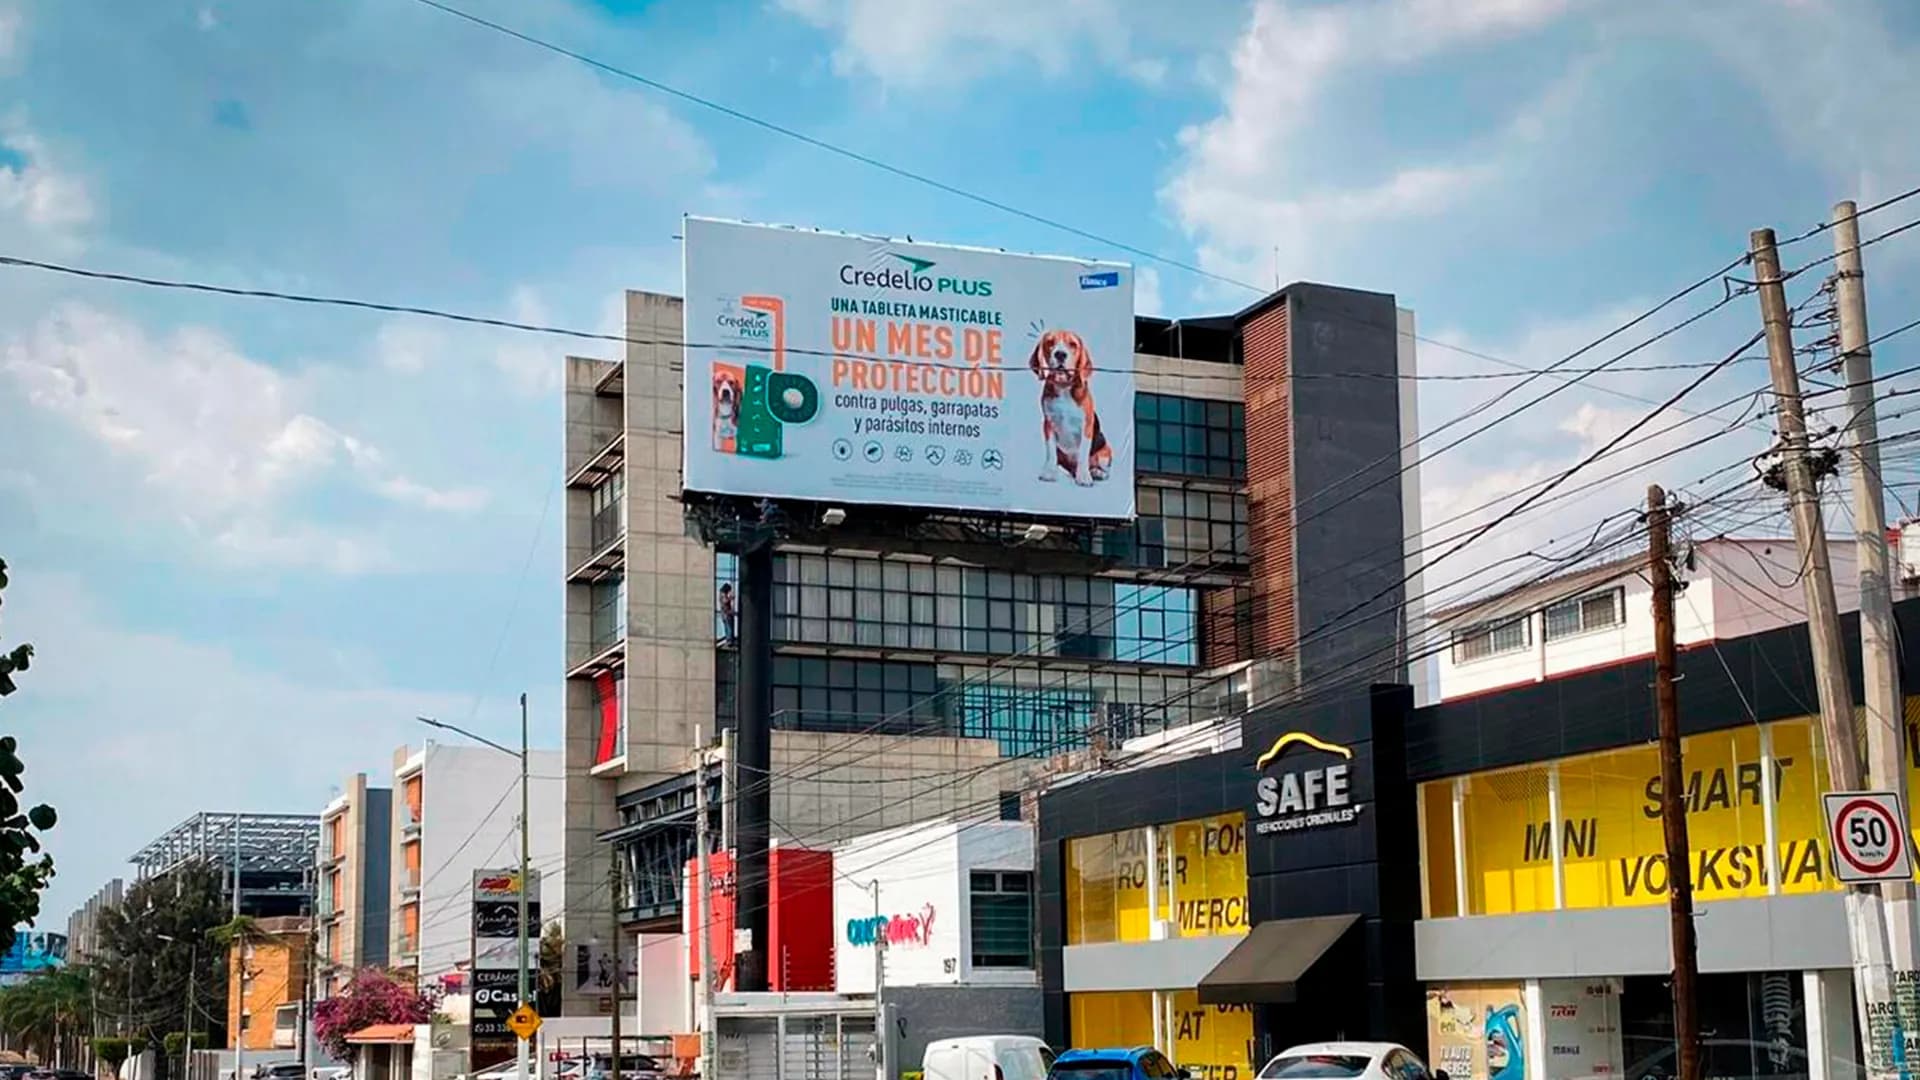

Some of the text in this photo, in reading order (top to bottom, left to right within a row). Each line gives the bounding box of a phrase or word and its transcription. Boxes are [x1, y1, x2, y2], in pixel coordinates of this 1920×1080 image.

[840, 264, 993, 297] Credelio PLUS
[717, 314, 769, 338] Credelio PLUS
[831, 297, 1003, 326] UNA TABLETA MASTICABLE
[831, 316, 1003, 364] UN MES DE
[832, 359, 1003, 401] PROTECCIÓN
[835, 394, 999, 421] contra pulgas, garrapatas
[854, 415, 981, 438] y parásitos internos
[1257, 764, 1349, 817] SAFE
[1523, 817, 1597, 863] MNI
[1850, 816, 1887, 848] 50
[1619, 838, 1837, 897] VOKSWA
[491, 989, 537, 1003] Casel
